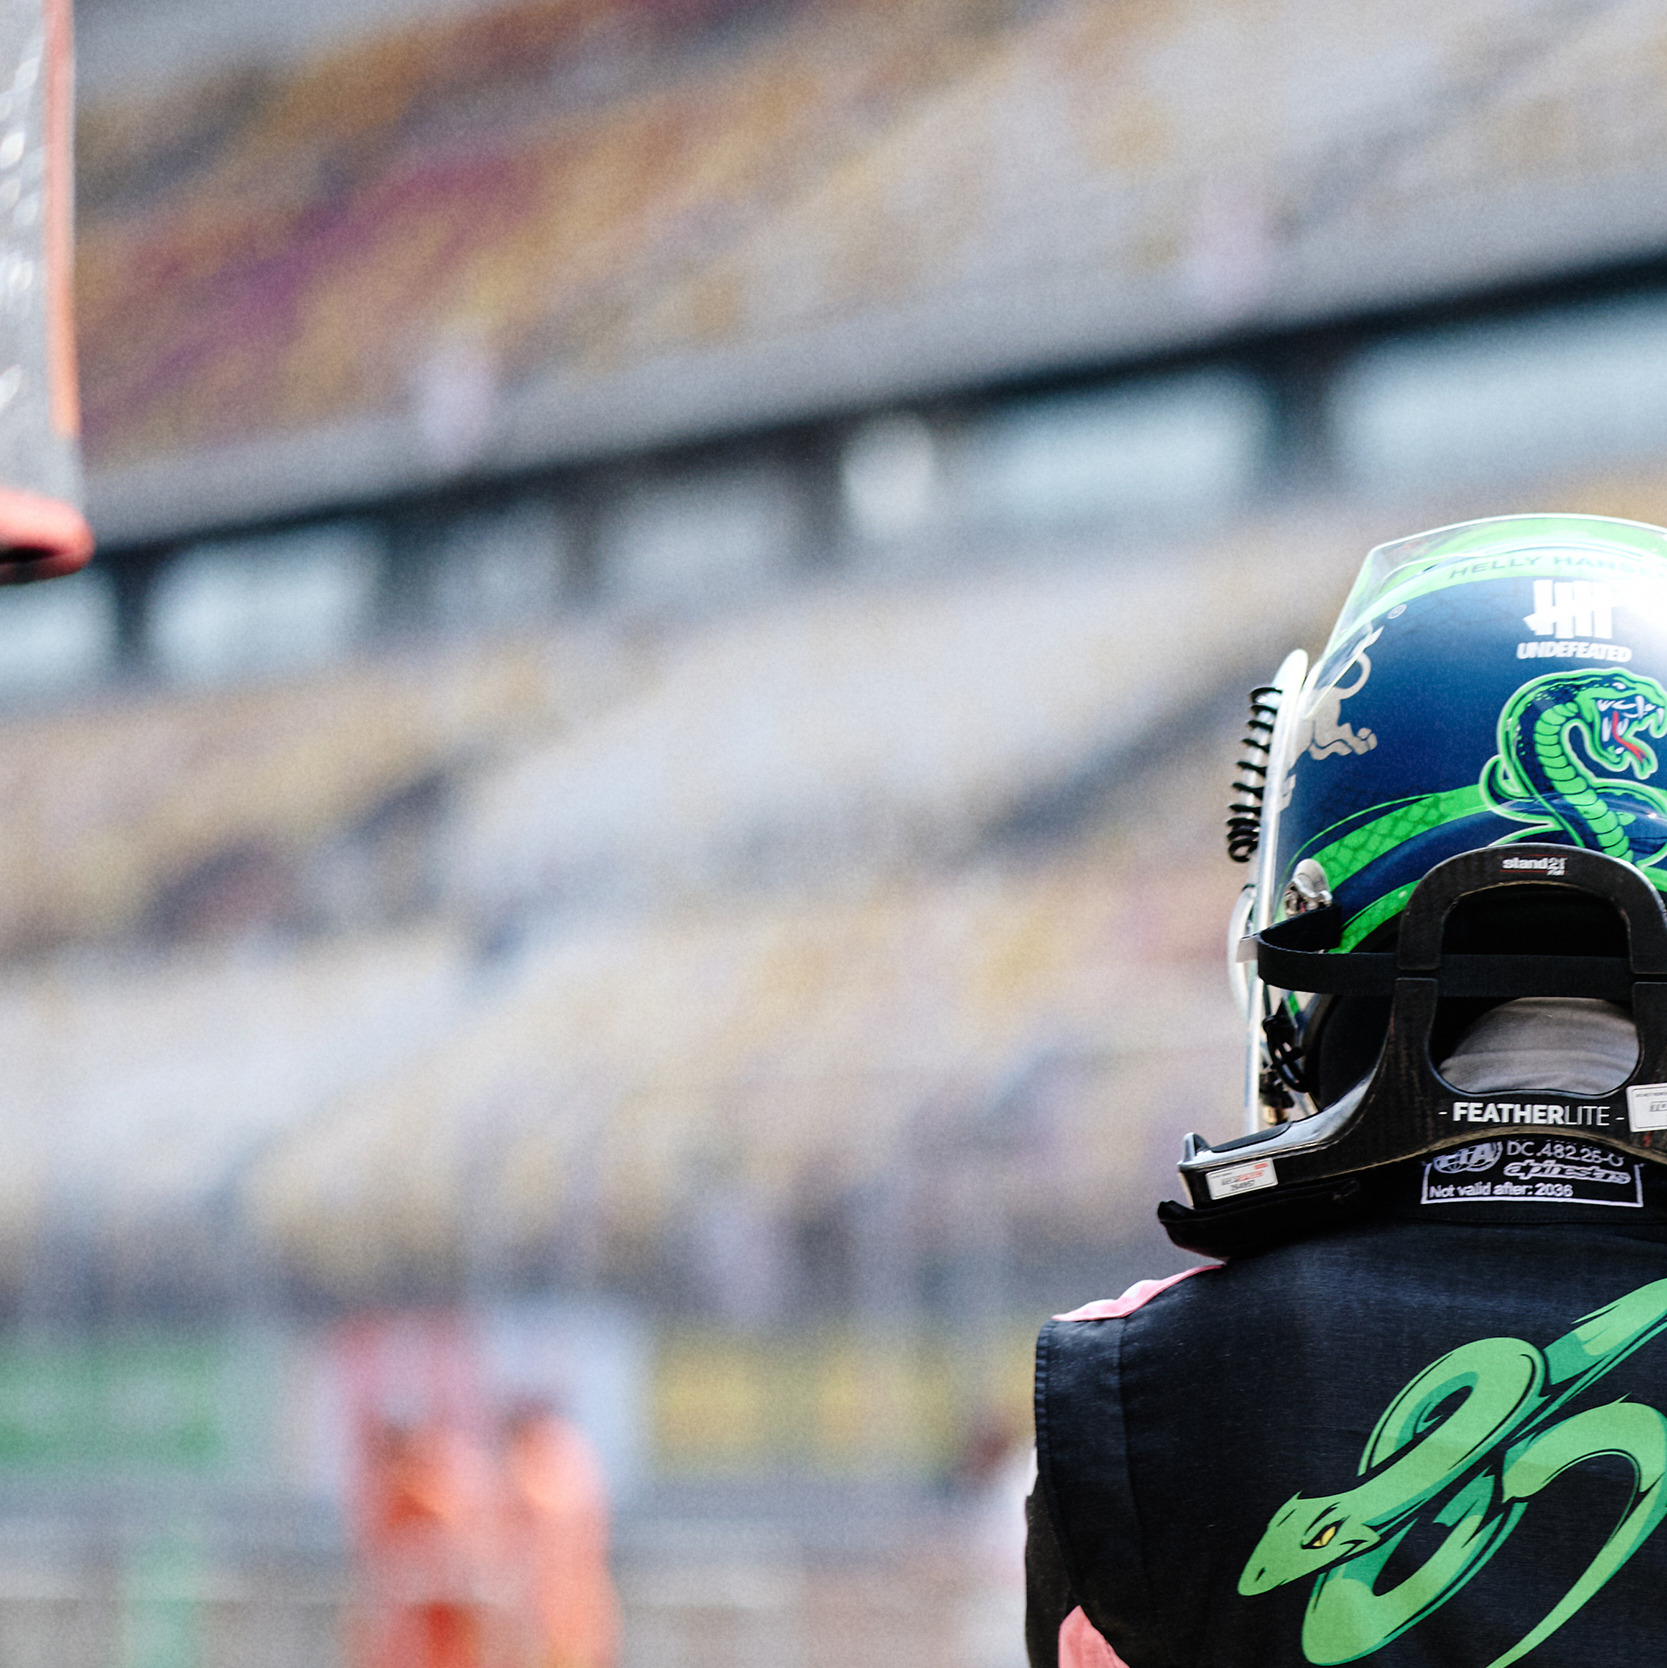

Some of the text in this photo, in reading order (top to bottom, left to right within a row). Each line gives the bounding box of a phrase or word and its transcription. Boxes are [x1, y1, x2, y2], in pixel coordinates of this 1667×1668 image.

[1450, 555, 1542, 579] HELLY
[1516, 641, 1633, 663] UNDEFEATED
[1452, 1102, 1611, 1126] FEATHERLITE
[1430, 1181, 1574, 1198] Not valid after: 2036
